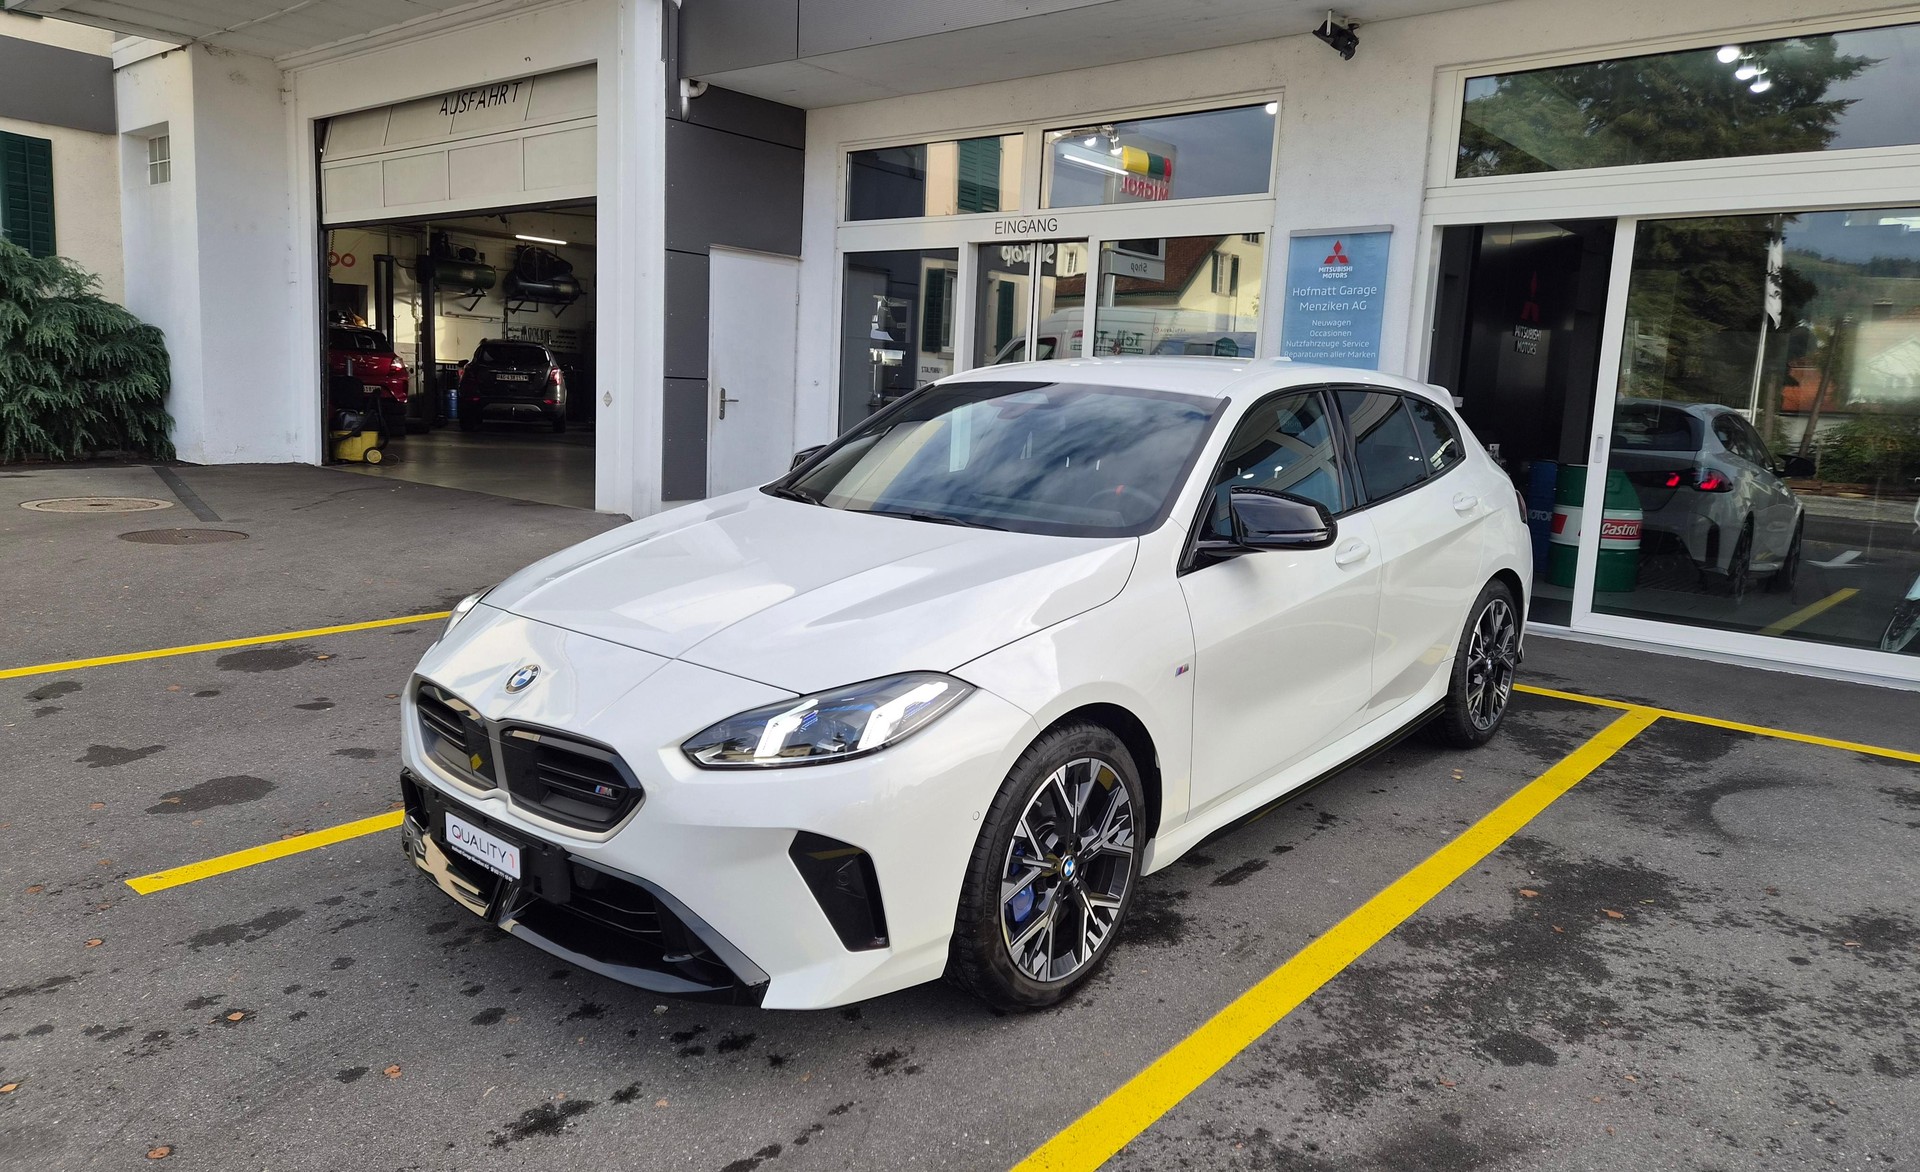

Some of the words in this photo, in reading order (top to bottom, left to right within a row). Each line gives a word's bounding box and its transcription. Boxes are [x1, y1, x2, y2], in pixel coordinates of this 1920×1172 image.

[439, 82, 523, 116] AUSFAHRT
[994, 218, 1058, 235] EINGANG
[1292, 286, 1336, 297] Hofmatt
[1339, 285, 1377, 297] Garage
[1299, 302, 1349, 311] Menziken
[1351, 300, 1367, 311] AG
[1312, 319, 1352, 328] Neuwagen
[1309, 329, 1352, 337] Occasionen
[1286, 340, 1340, 349] Nutzfahrzeuge
[1342, 340, 1370, 348] Service
[1284, 350, 1329, 359] Reparaturen
[1602, 522, 1638, 536] Castrol
[452, 824, 507, 863] QUALITY
[509, 853, 515, 868] 1
